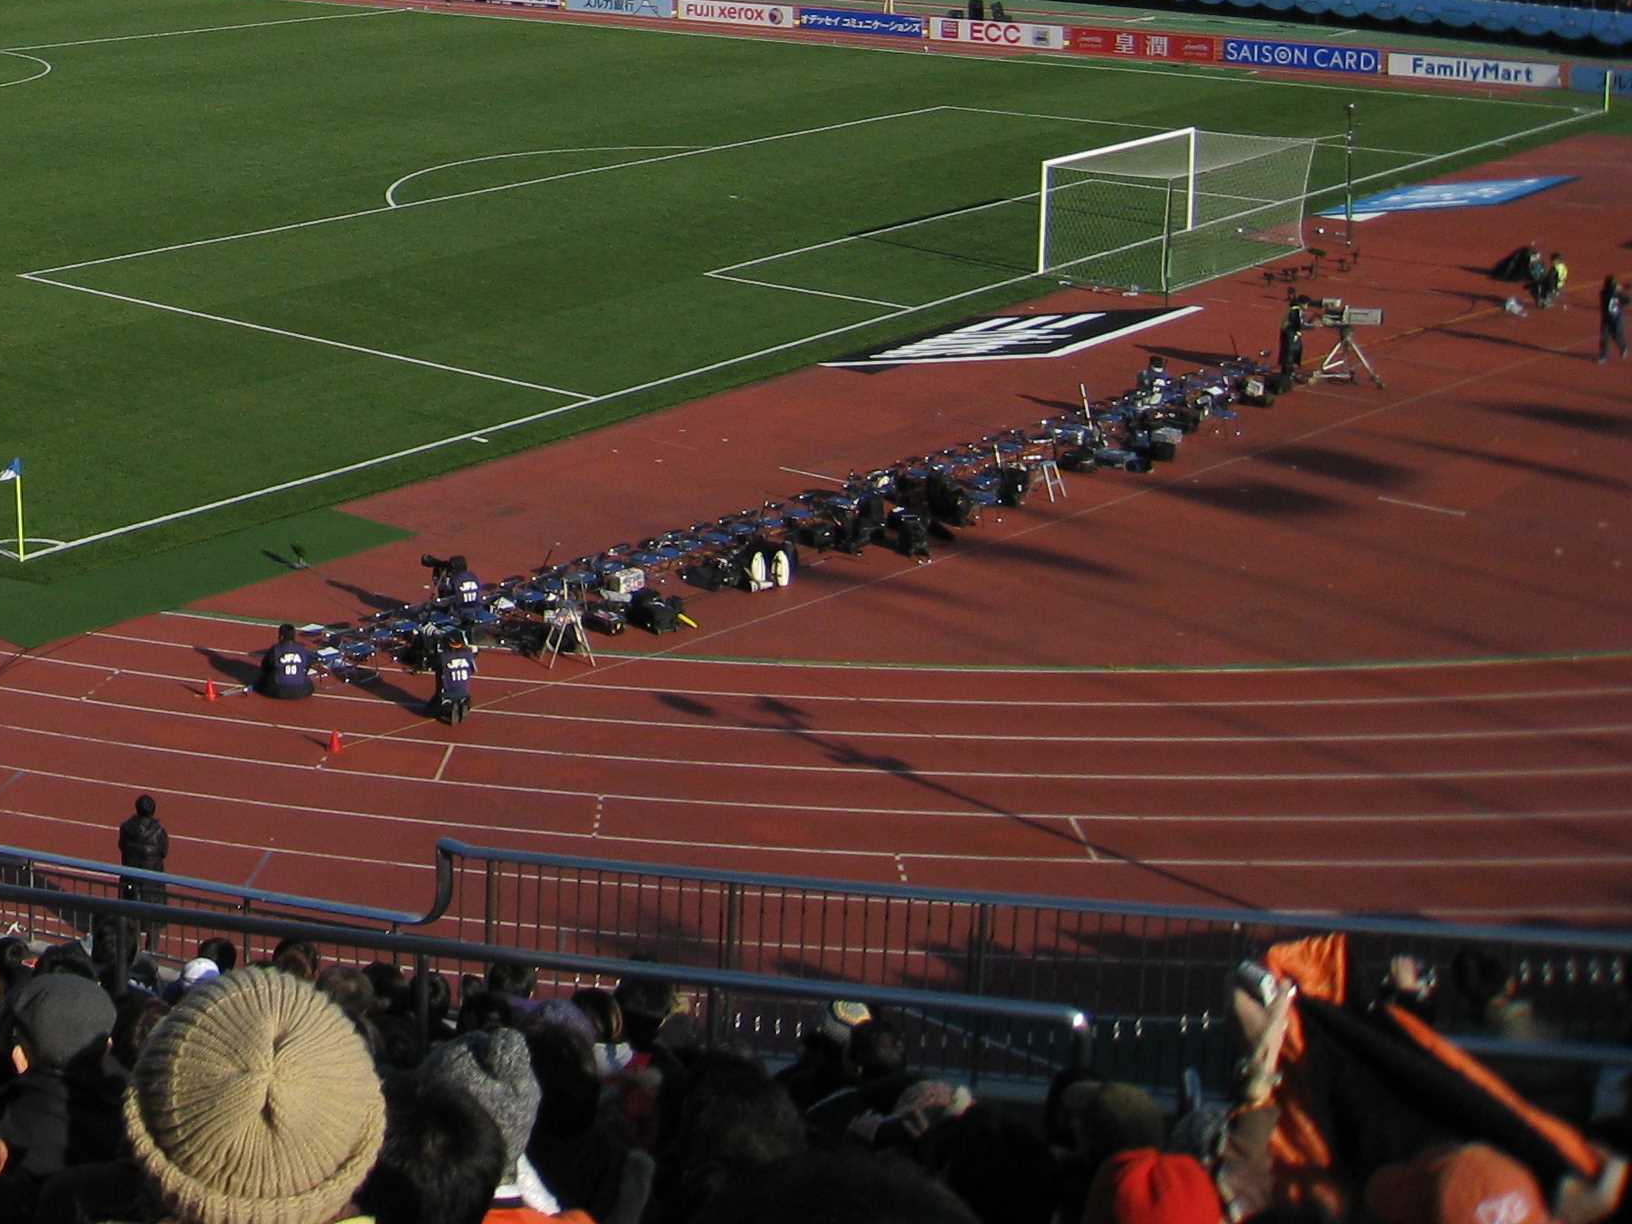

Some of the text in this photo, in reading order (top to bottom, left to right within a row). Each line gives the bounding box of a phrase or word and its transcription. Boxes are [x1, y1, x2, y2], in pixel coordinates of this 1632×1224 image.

[686, 3, 764, 21] FUJI xerox
[970, 22, 1021, 43] ECC
[1226, 42, 1308, 65] SAISON
[1314, 48, 1376, 71] CARD
[1412, 57, 1533, 82] FamilyMart
[279, 653, 302, 664] JFA
[447, 658, 469, 670] JFA
